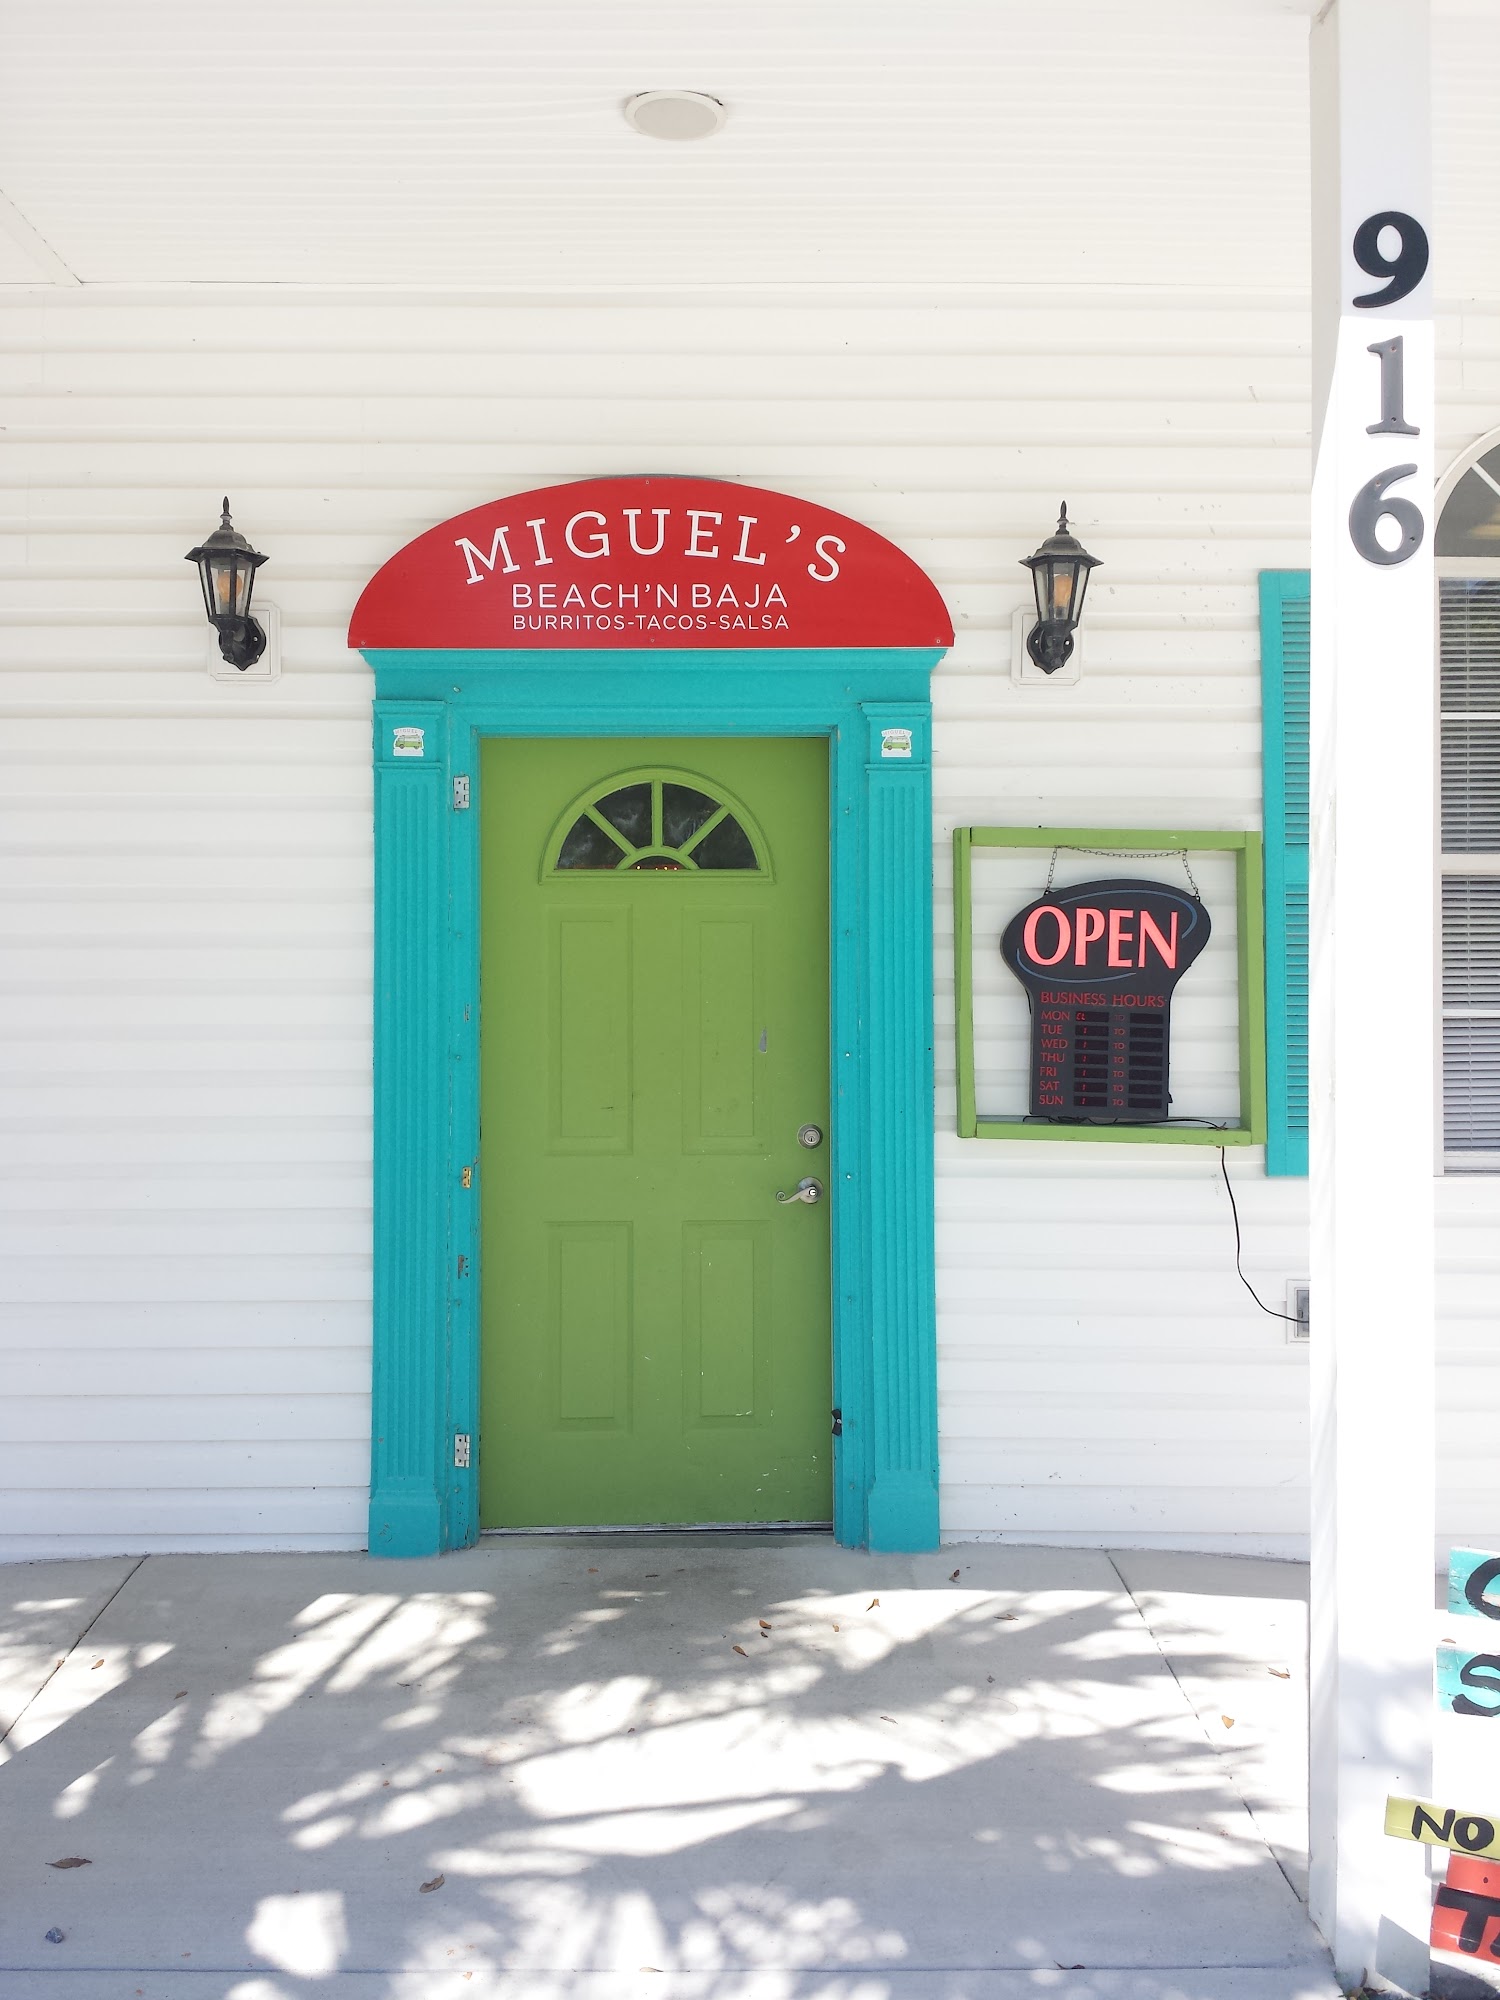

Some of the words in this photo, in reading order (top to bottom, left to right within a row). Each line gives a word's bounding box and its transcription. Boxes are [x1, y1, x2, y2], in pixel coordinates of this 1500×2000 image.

[455, 509, 847, 584] MIGUEL'S
[512, 583, 678, 609] BEACH'N
[691, 583, 789, 609] BAJA
[513, 614, 790, 631] BURRITOS-TACOS-SALSA
[1023, 905, 1178, 969] OPEN
[1040, 991, 1107, 1006] BUSINESS
[1112, 994, 1165, 1008] HOURS
[1040, 1010, 1071, 1021] MON
[1041, 1024, 1063, 1035] TUE
[1041, 1038, 1069, 1049] WED
[1041, 1052, 1065, 1063] THU
[1039, 1066, 1058, 1077] FRI
[1039, 1080, 1060, 1091] SAT
[1039, 1094, 1064, 1105] SUN
[1411, 1805, 1495, 1851] NO
[1436, 1885, 1500, 1958] T
